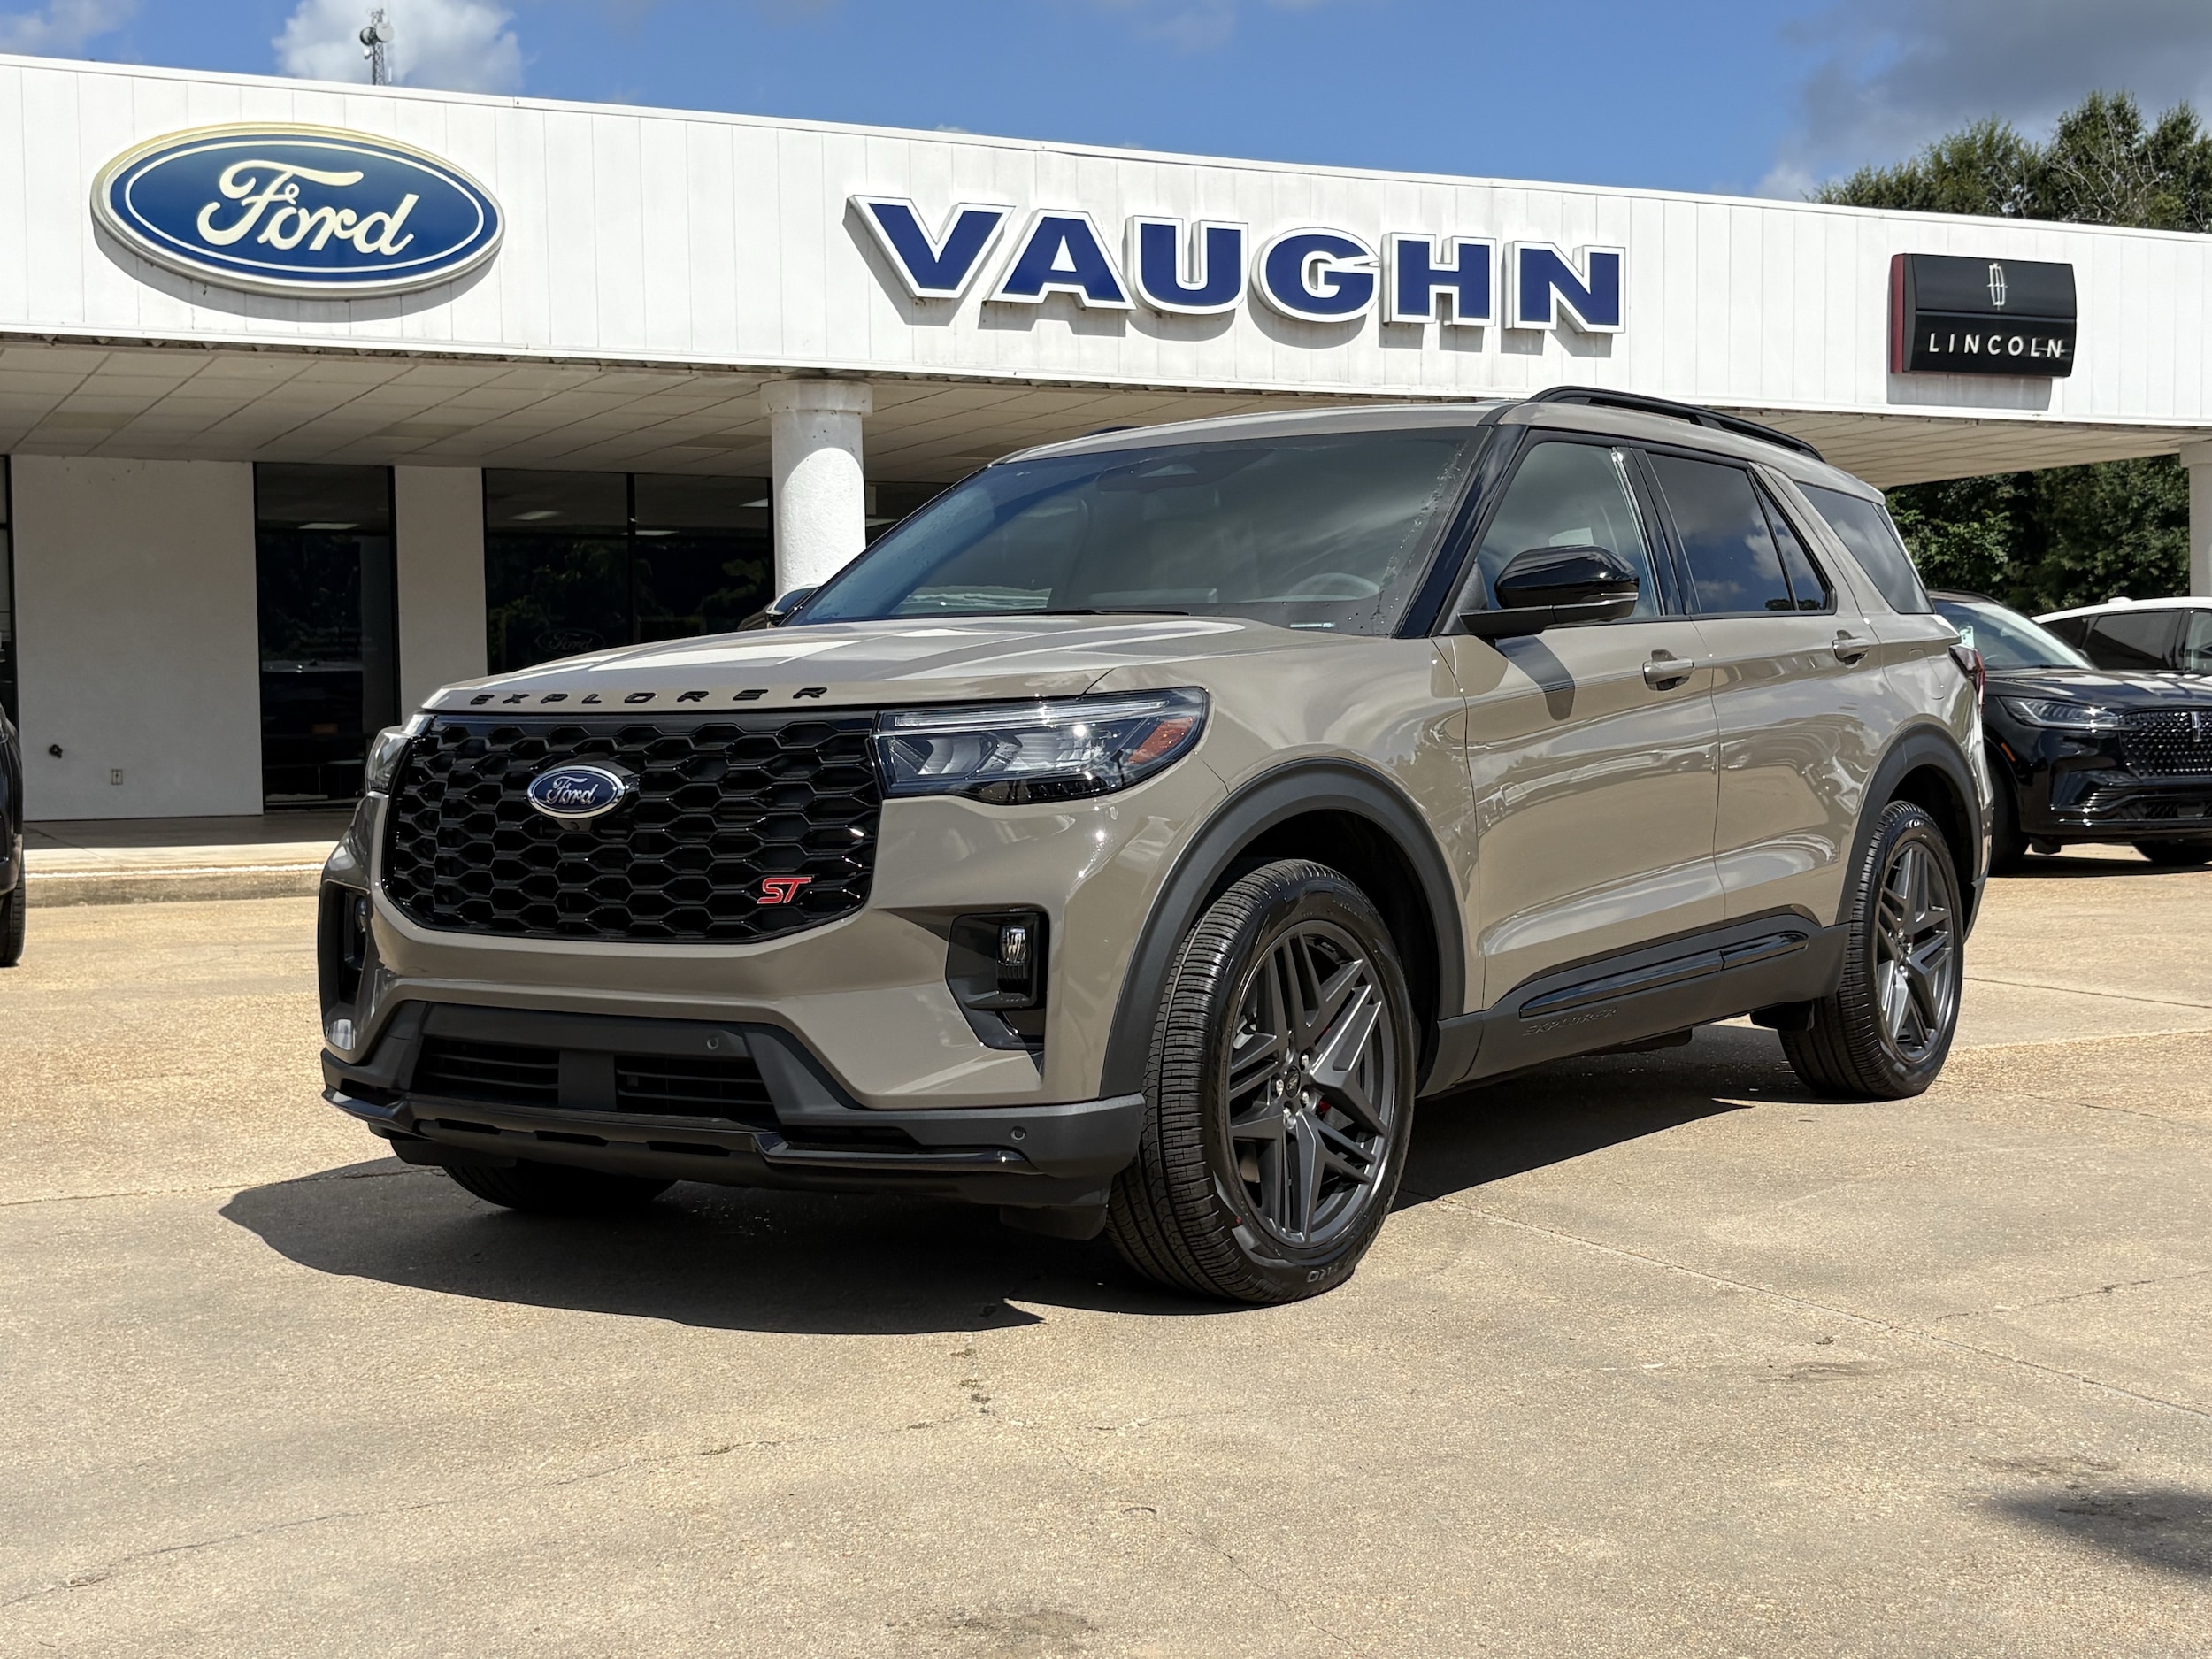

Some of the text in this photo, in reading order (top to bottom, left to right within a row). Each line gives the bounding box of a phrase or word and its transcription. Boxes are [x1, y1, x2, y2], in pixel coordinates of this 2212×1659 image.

[196, 159, 419, 256] Ford
[850, 196, 1625, 334] VAUGHN
[1928, 332, 2062, 359] LINCOLN
[548, 633, 594, 651] Ford
[470, 687, 828, 706] EXPLORER
[545, 775, 599, 805] Ford
[756, 876, 812, 904] ST
